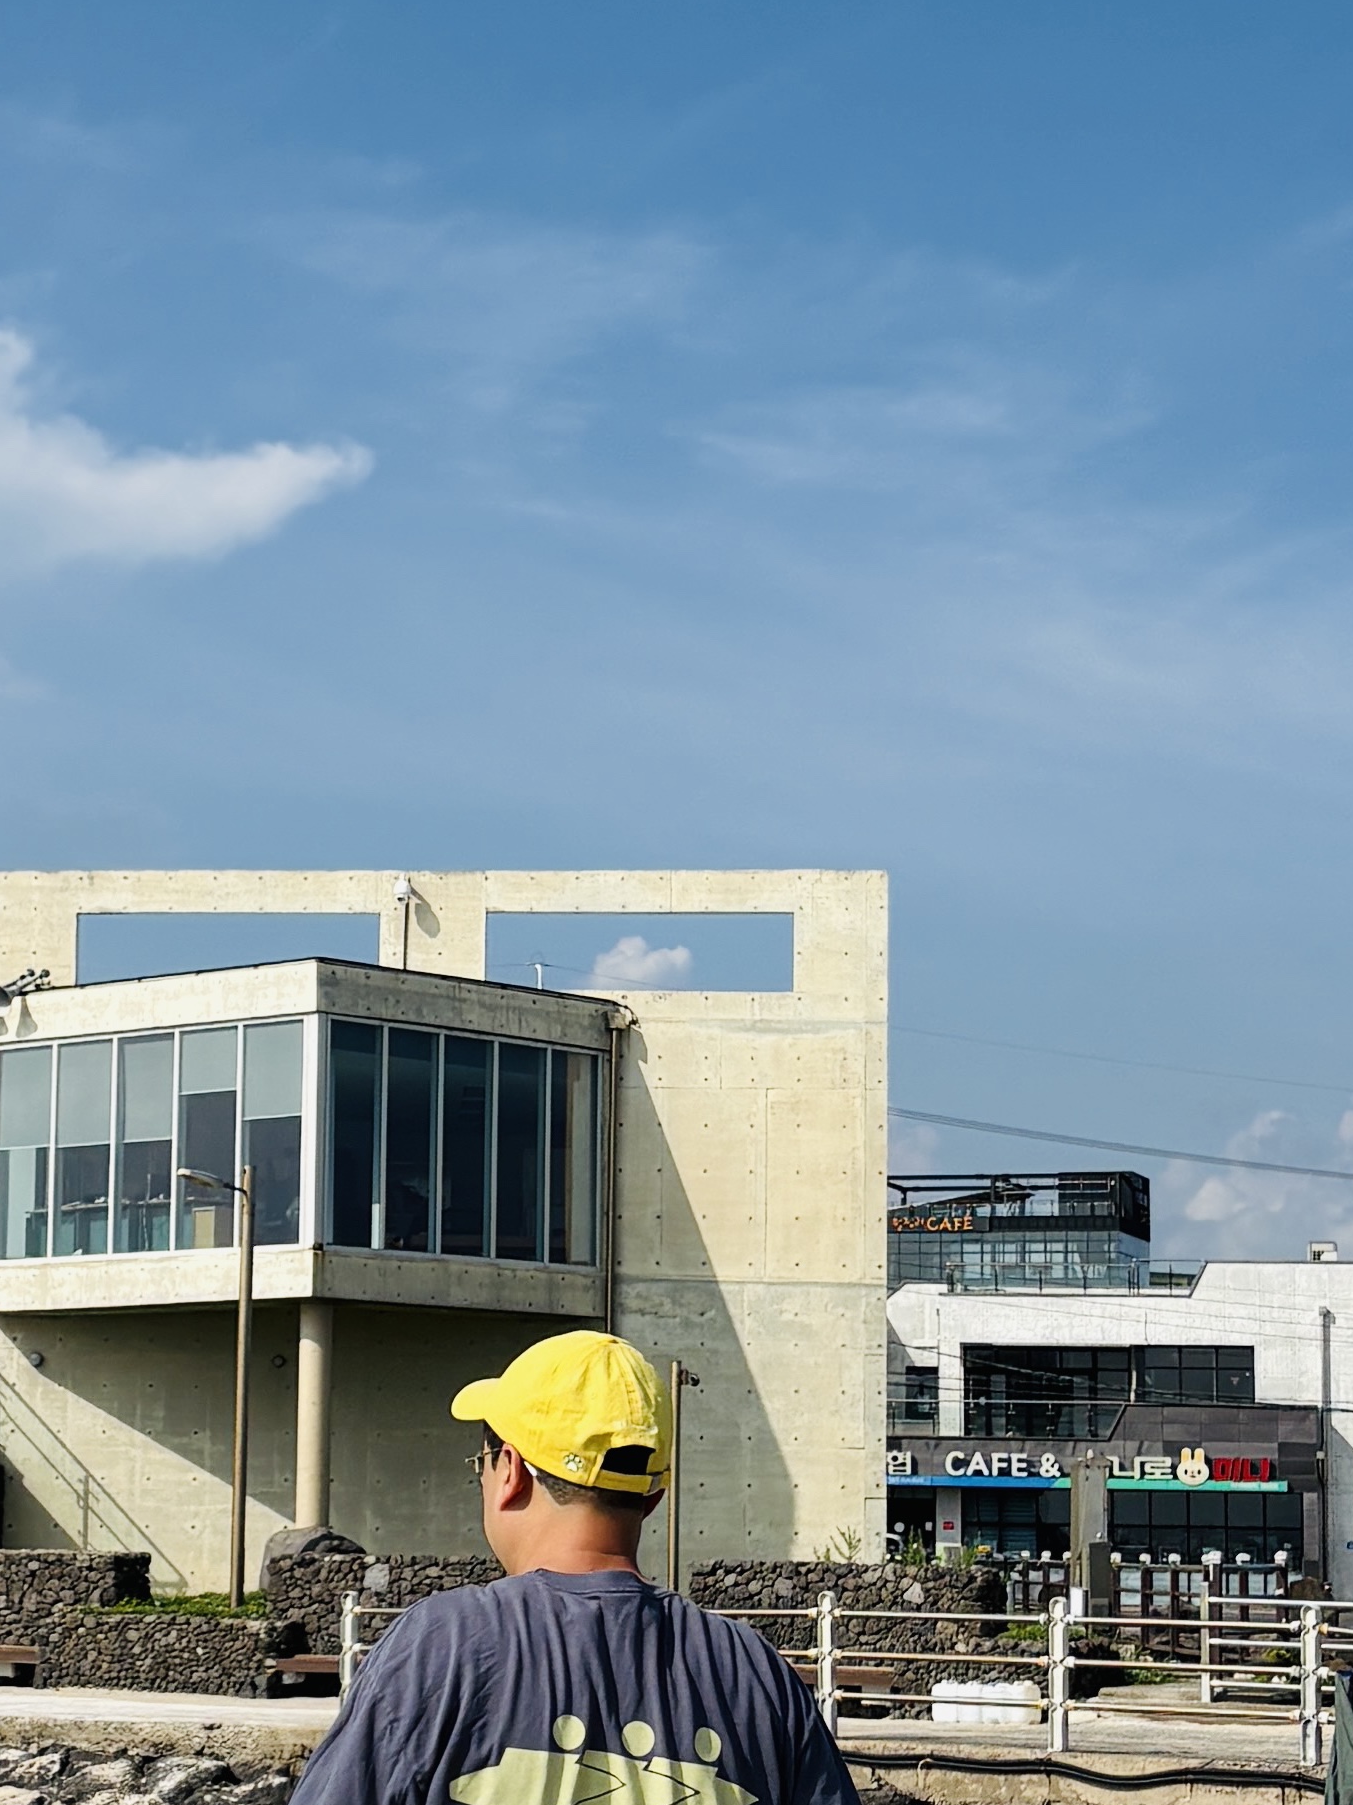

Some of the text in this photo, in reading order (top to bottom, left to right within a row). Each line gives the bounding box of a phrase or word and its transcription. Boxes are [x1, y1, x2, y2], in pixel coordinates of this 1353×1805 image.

[927, 1217, 973, 1231] CAFE
[945, 1451, 1027, 1477] CAFE
[1039, 1453, 1060, 1477] &
[1078, 1455, 1173, 1480] 나로
[1212, 1458, 1270, 1482] 미니
